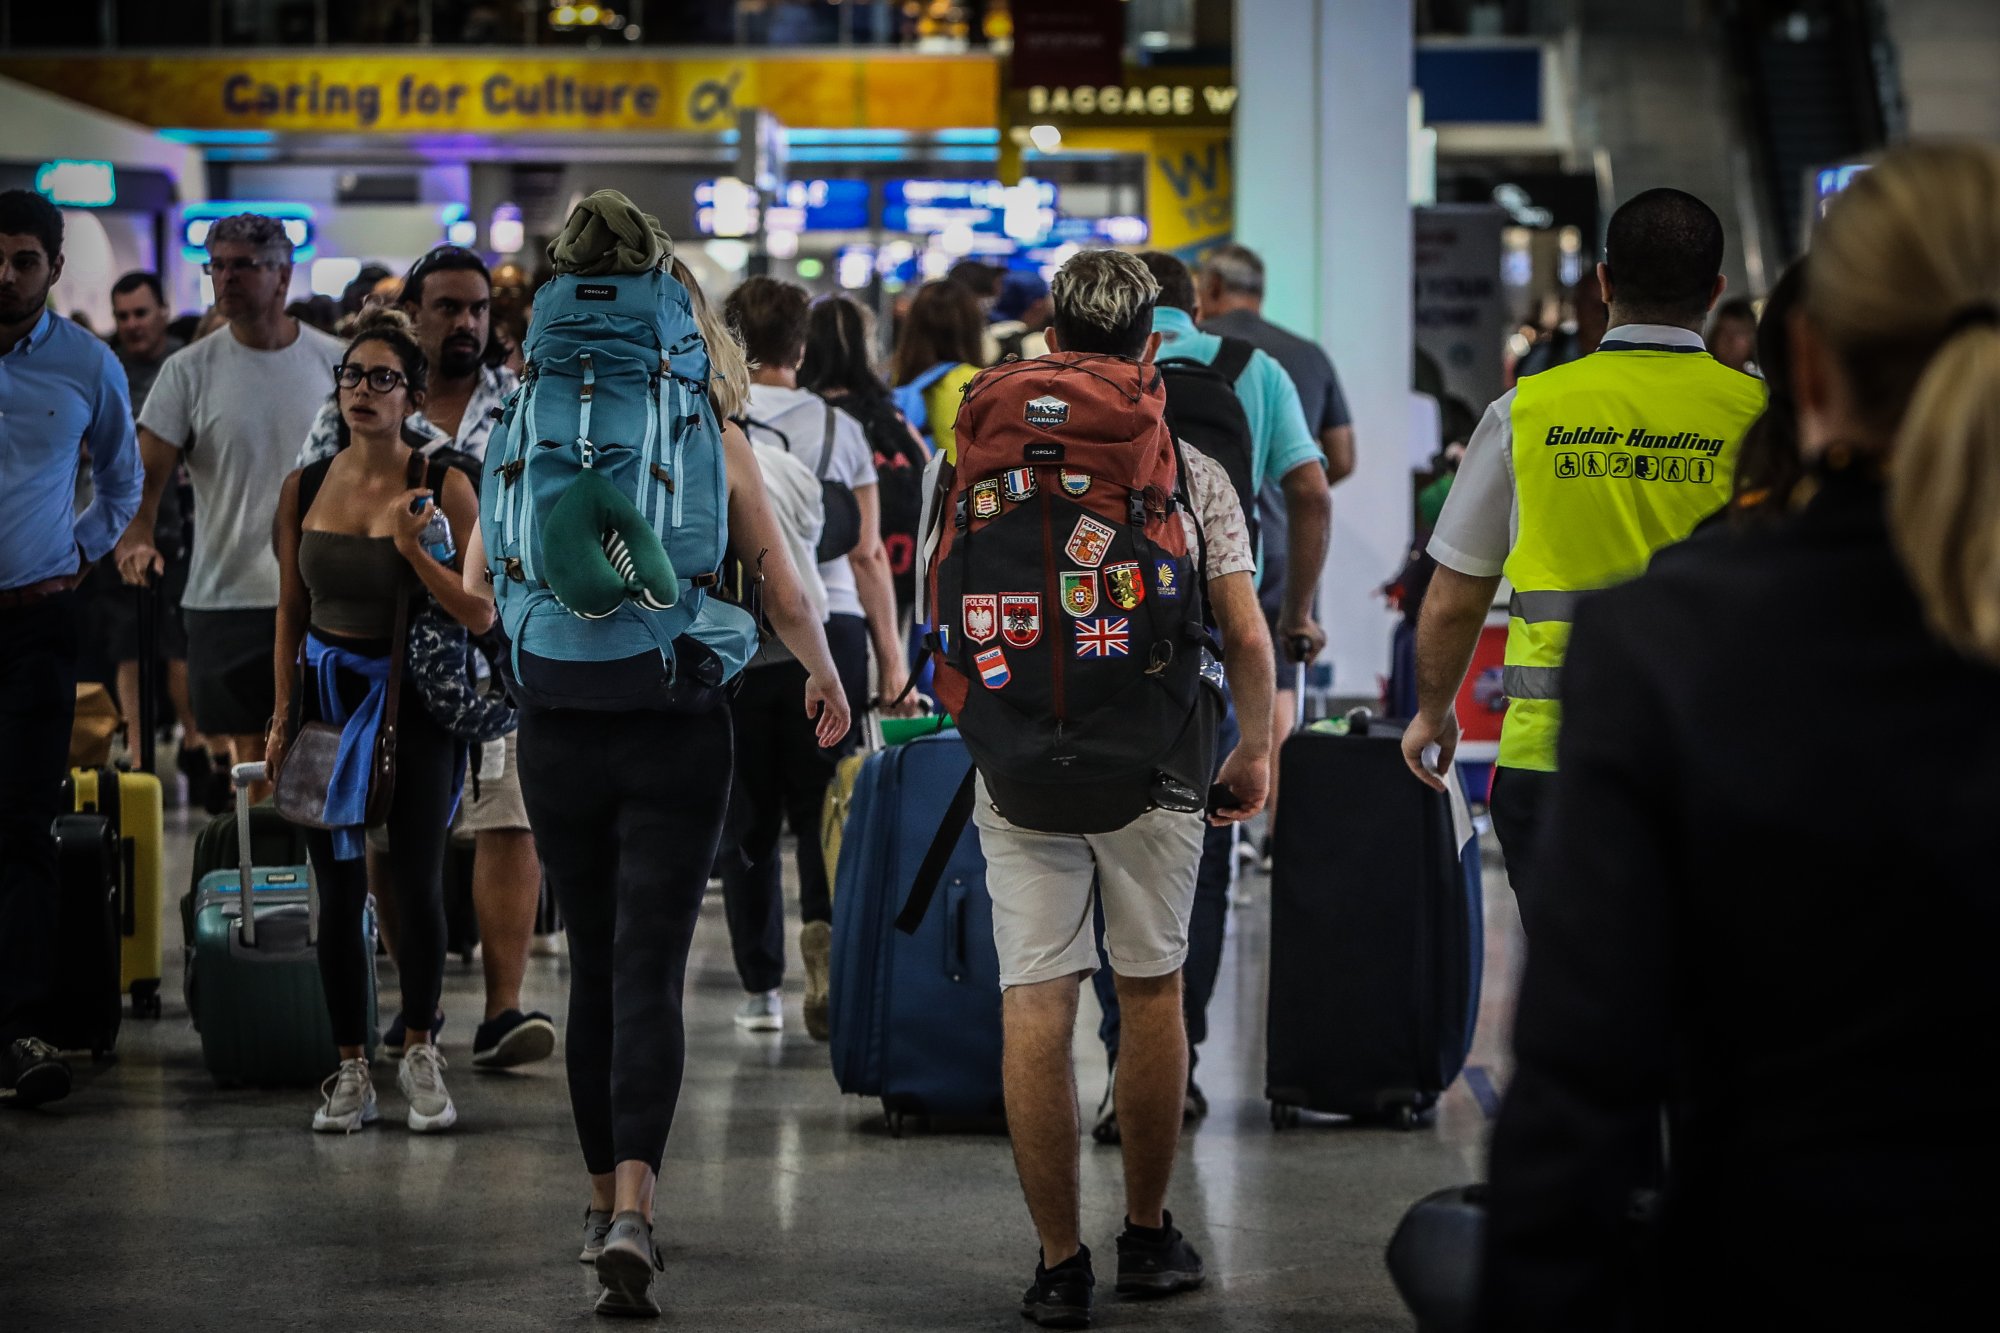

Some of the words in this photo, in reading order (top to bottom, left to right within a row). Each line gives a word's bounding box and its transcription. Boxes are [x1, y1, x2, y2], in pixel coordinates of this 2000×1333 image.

[223, 72, 381, 126] Caring
[399, 72, 467, 115] for
[482, 72, 661, 116] Culture
[1027, 84, 1195, 115] BAGGAGE
[1032, 416, 1059, 424] CANADA
[1545, 425, 1624, 446] Goldair
[1625, 428, 1725, 457] Handling
[1084, 521, 1109, 536] ESPAÑA
[965, 598, 994, 607] POLSKA
[977, 650, 999, 662] HOLLAND
